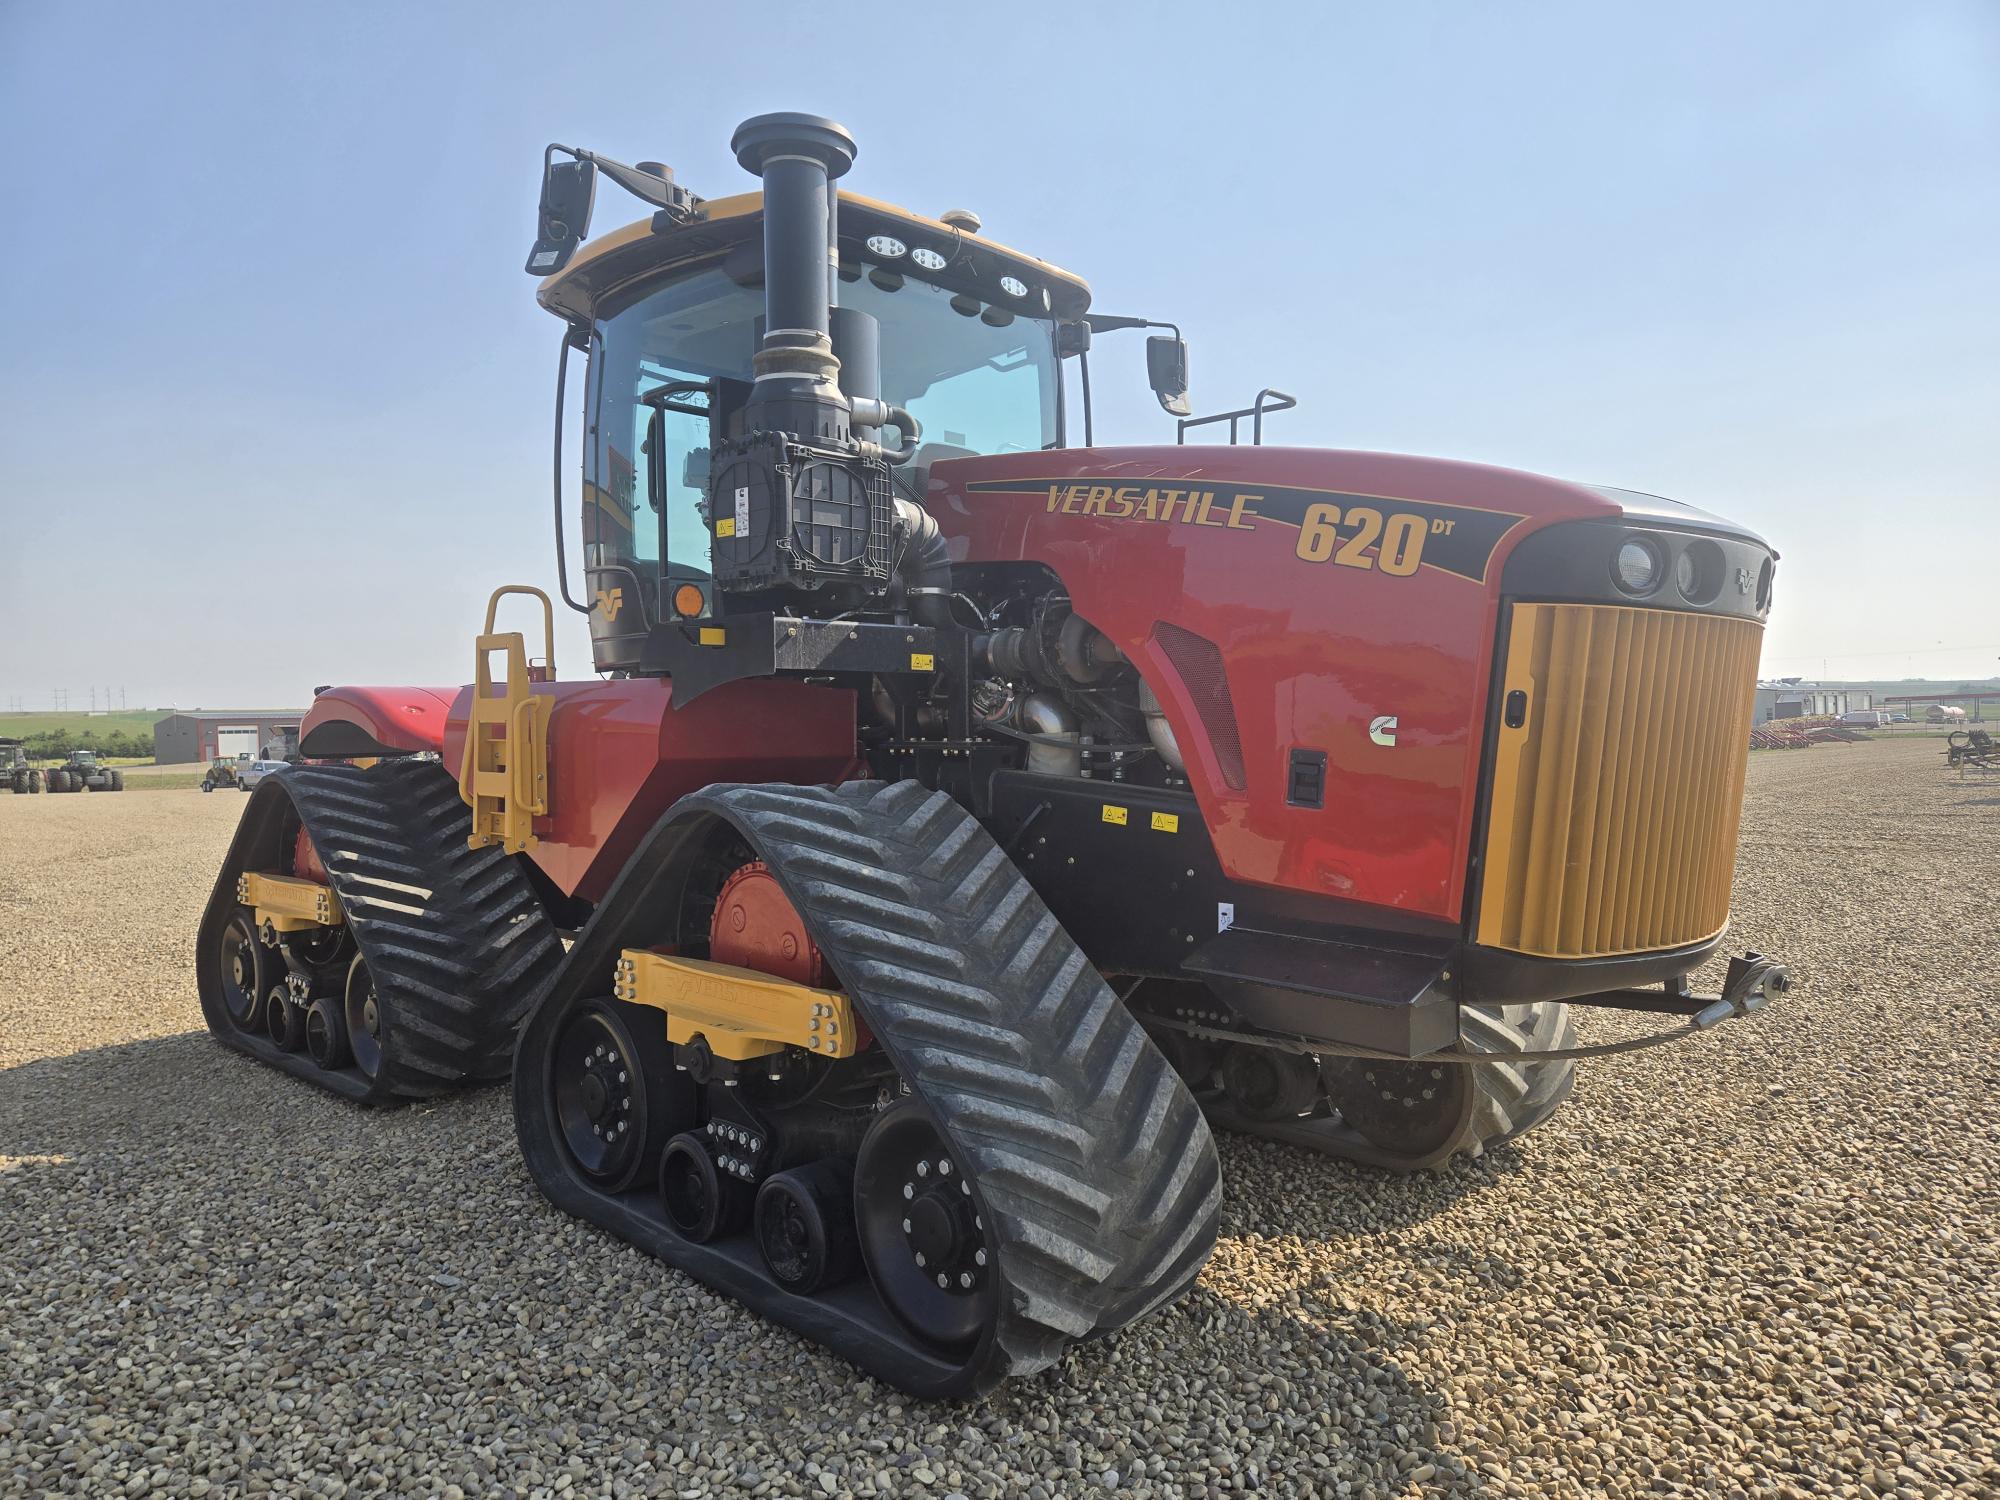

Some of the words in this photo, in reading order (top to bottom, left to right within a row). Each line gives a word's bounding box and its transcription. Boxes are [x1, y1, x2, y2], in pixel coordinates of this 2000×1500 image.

[1046, 484, 1265, 531] VERSATILE
[1296, 503, 1428, 577] 620
[1431, 518, 1456, 536] DT
